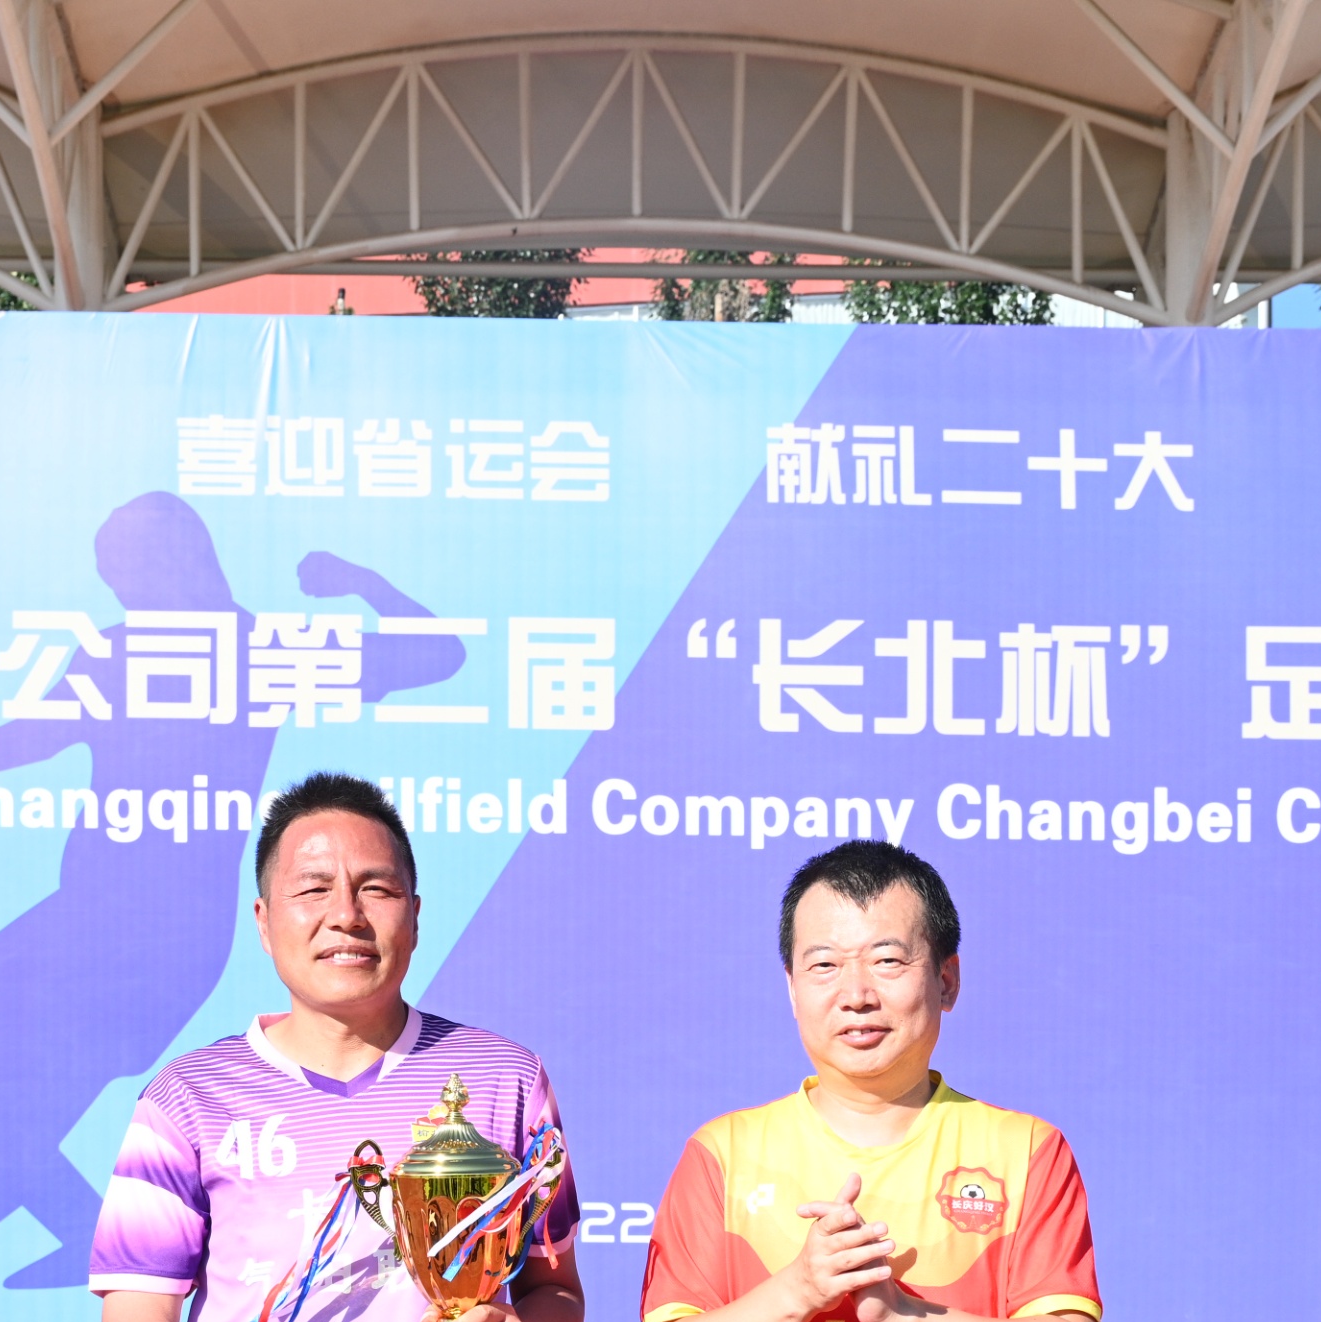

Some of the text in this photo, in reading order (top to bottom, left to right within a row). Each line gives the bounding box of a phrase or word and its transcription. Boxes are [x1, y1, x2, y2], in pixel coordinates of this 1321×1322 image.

[177, 414, 1195, 512] 喜迎省运会 献礼二十大
[378, 776, 568, 835] ilfield
[592, 777, 915, 850] Company
[936, 782, 1253, 855] Changbei
[214, 1112, 298, 1180] 46
[951, 1200, 995, 1213] 长庆好汉
